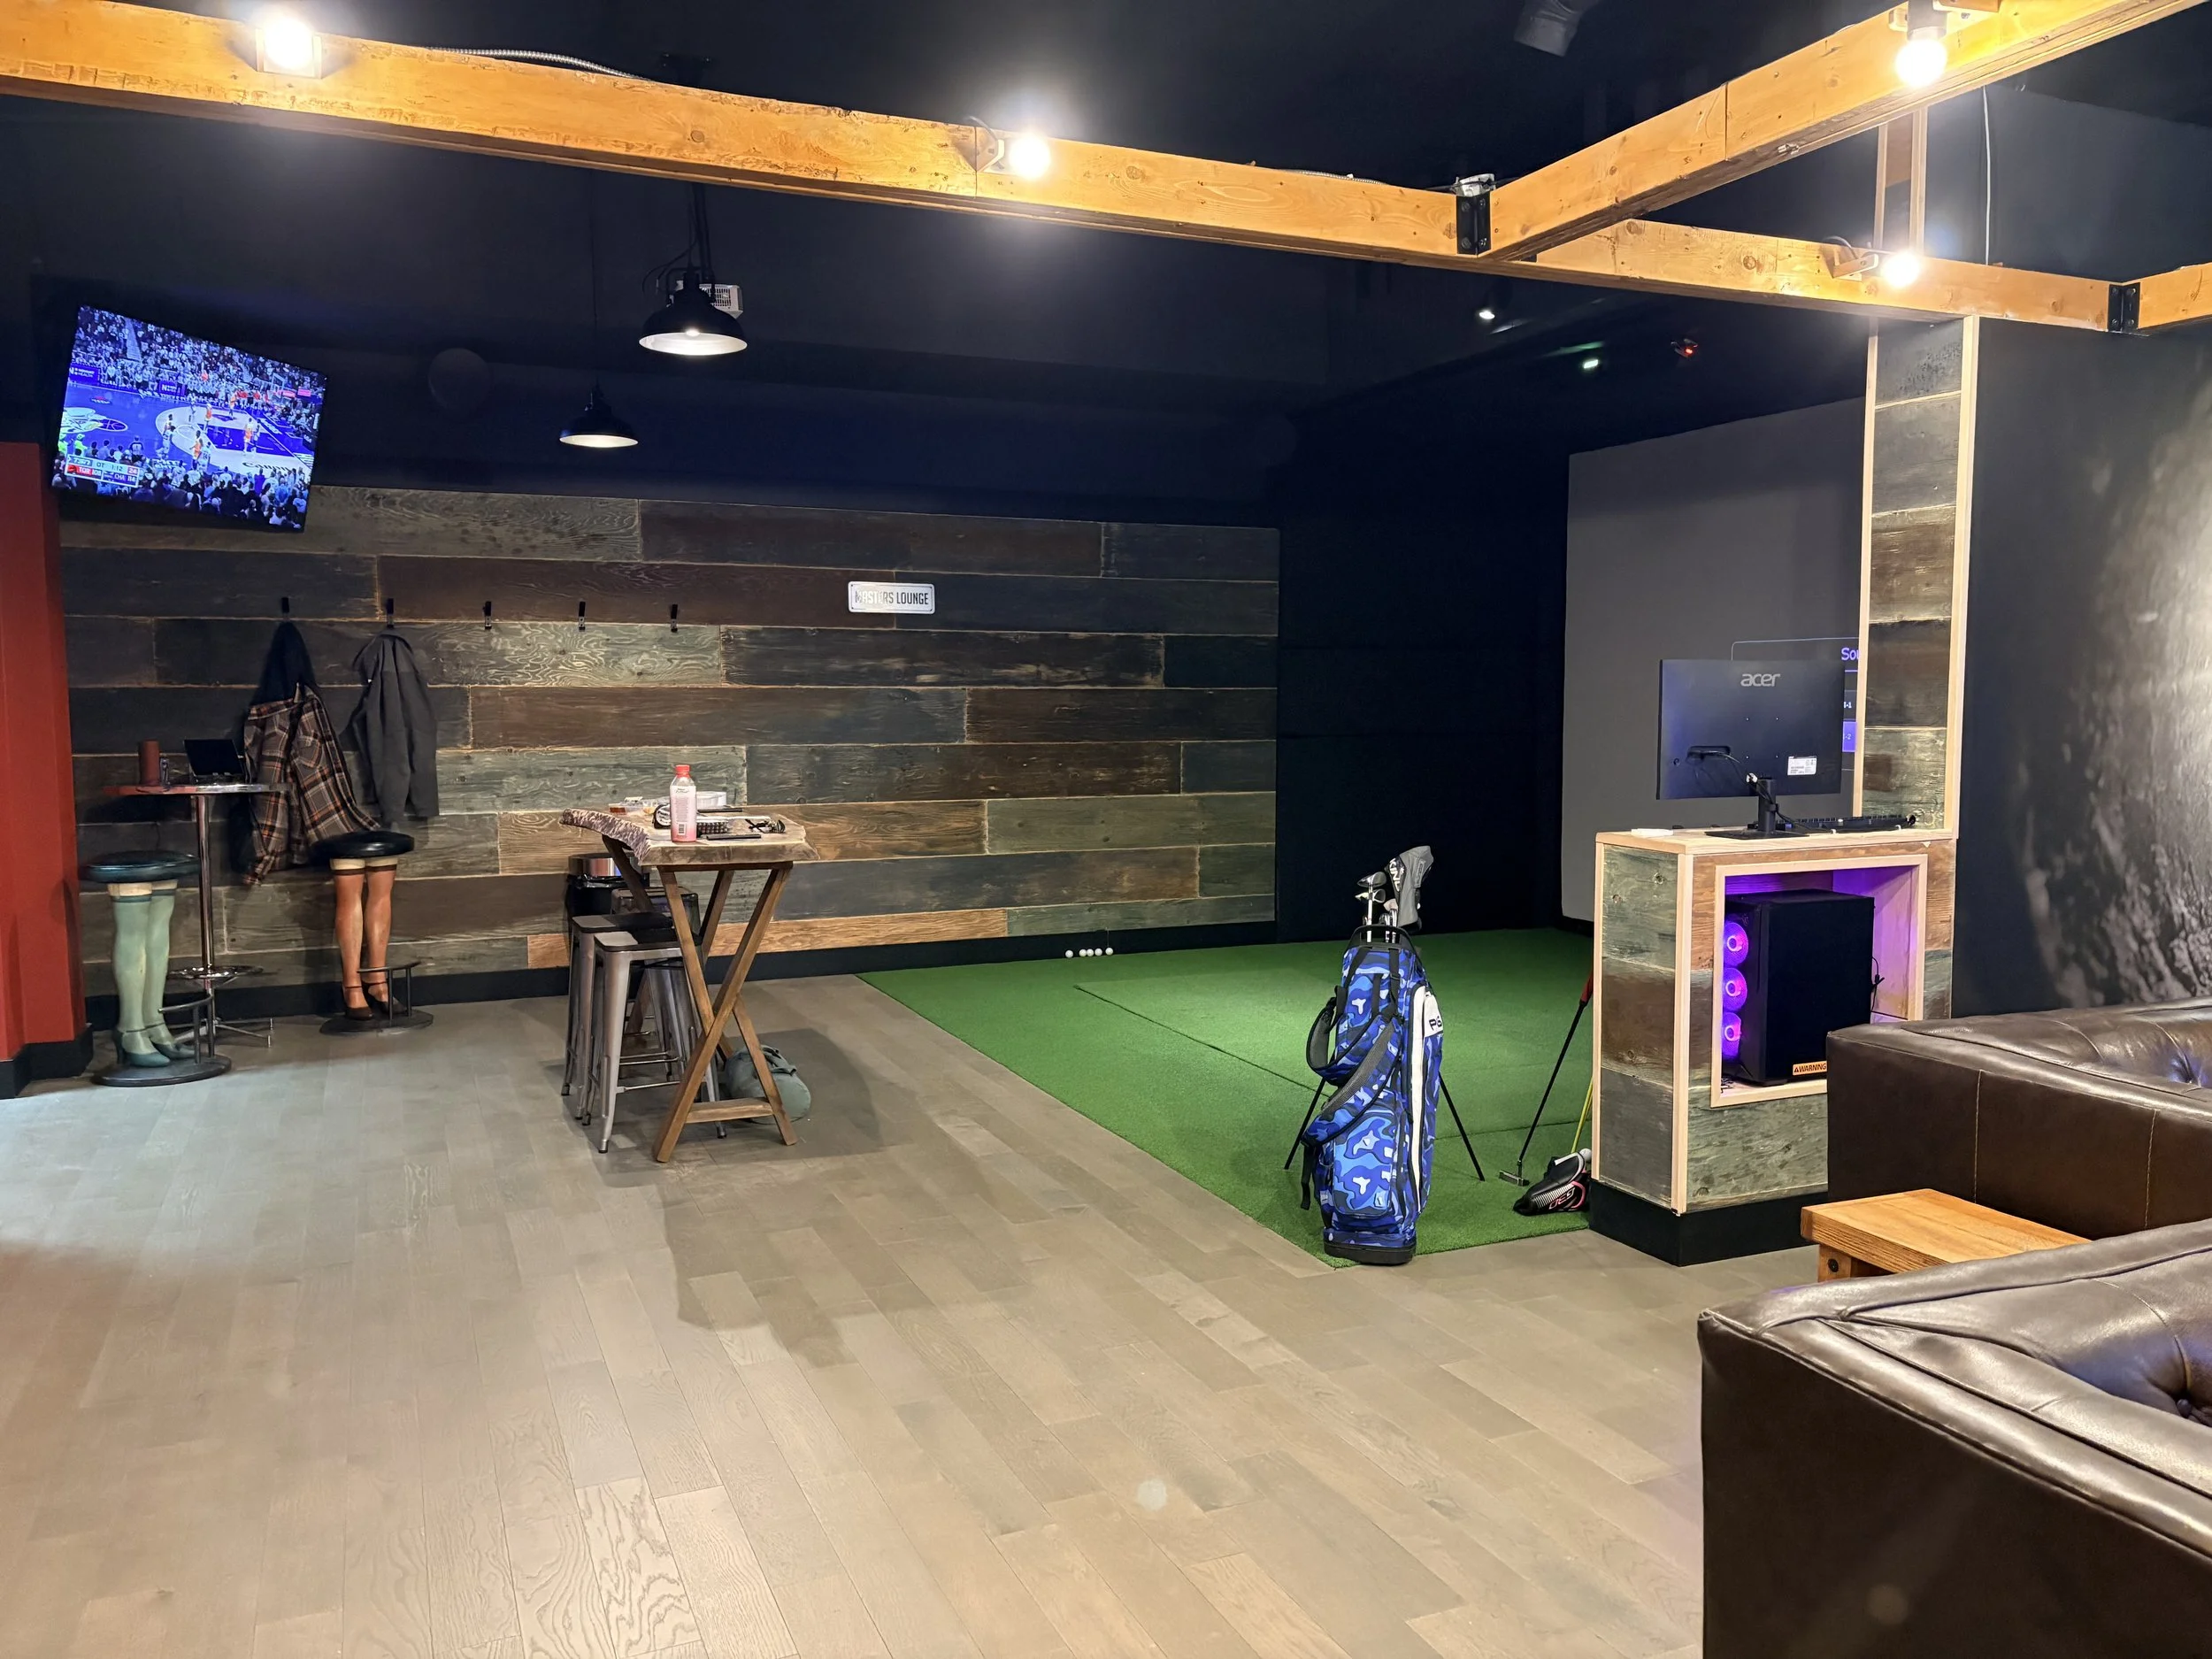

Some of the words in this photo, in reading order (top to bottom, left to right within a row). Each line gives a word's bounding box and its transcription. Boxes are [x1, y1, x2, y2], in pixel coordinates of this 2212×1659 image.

[896, 592, 929, 605] LOUNGE
[1740, 673, 1781, 687] acer
[1799, 1063, 1826, 1072] WARNING
